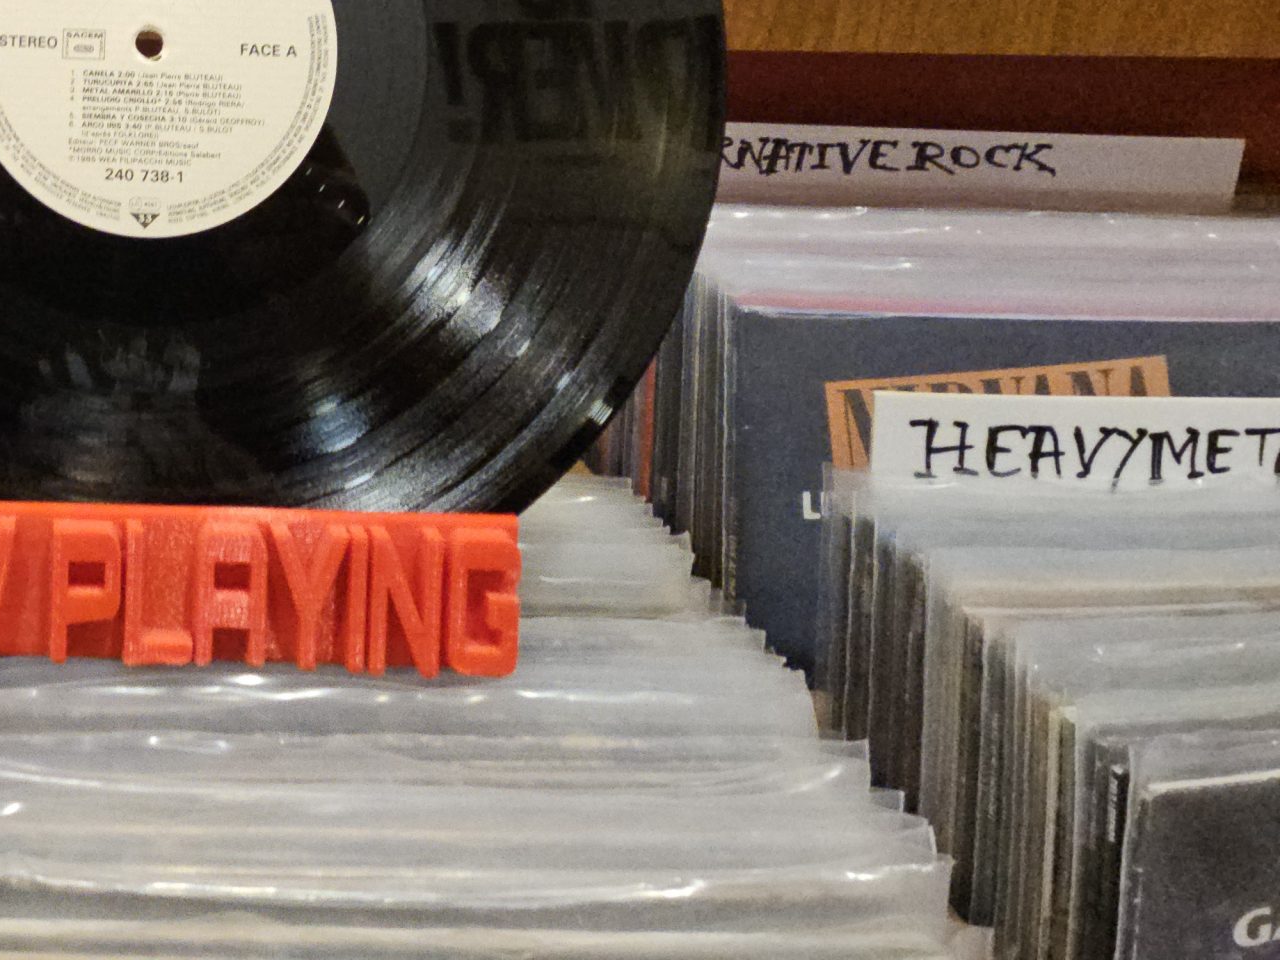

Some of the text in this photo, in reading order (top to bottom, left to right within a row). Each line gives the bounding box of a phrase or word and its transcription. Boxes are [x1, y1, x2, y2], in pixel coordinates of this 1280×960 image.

[240, 44, 297, 57] FACE A
[720, 136, 1056, 177] RNATIVE ROCK
[105, 168, 184, 183] 240 738-1
[49, 515, 519, 678] PLAYING
